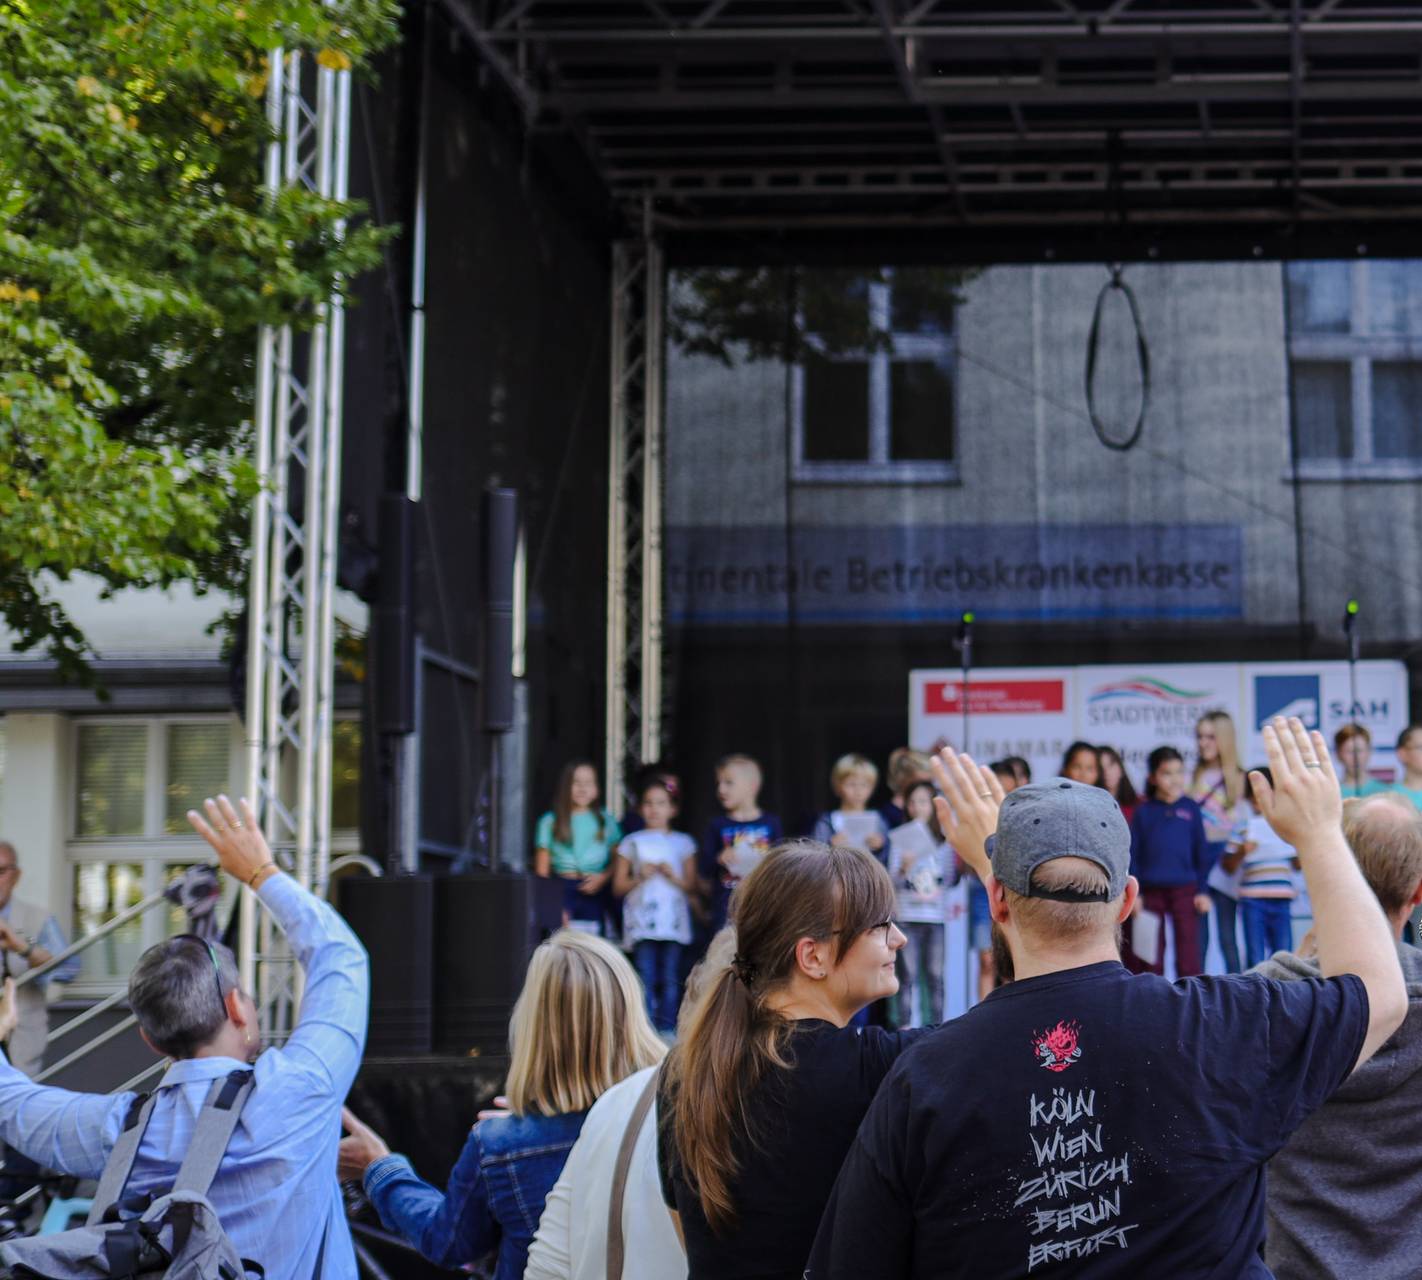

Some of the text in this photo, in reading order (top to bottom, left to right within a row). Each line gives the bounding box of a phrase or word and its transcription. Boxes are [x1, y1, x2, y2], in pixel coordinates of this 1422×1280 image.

[671, 554, 1229, 596] tinentale Betriebskrankenkasse
[1088, 703, 1219, 727] STADTWER
[1329, 700, 1389, 719] SAH
[1030, 1087, 1095, 1127] KÖLN
[1027, 1186, 1120, 1236] BERLIN
[1028, 1223, 1139, 1273] ERFURT
